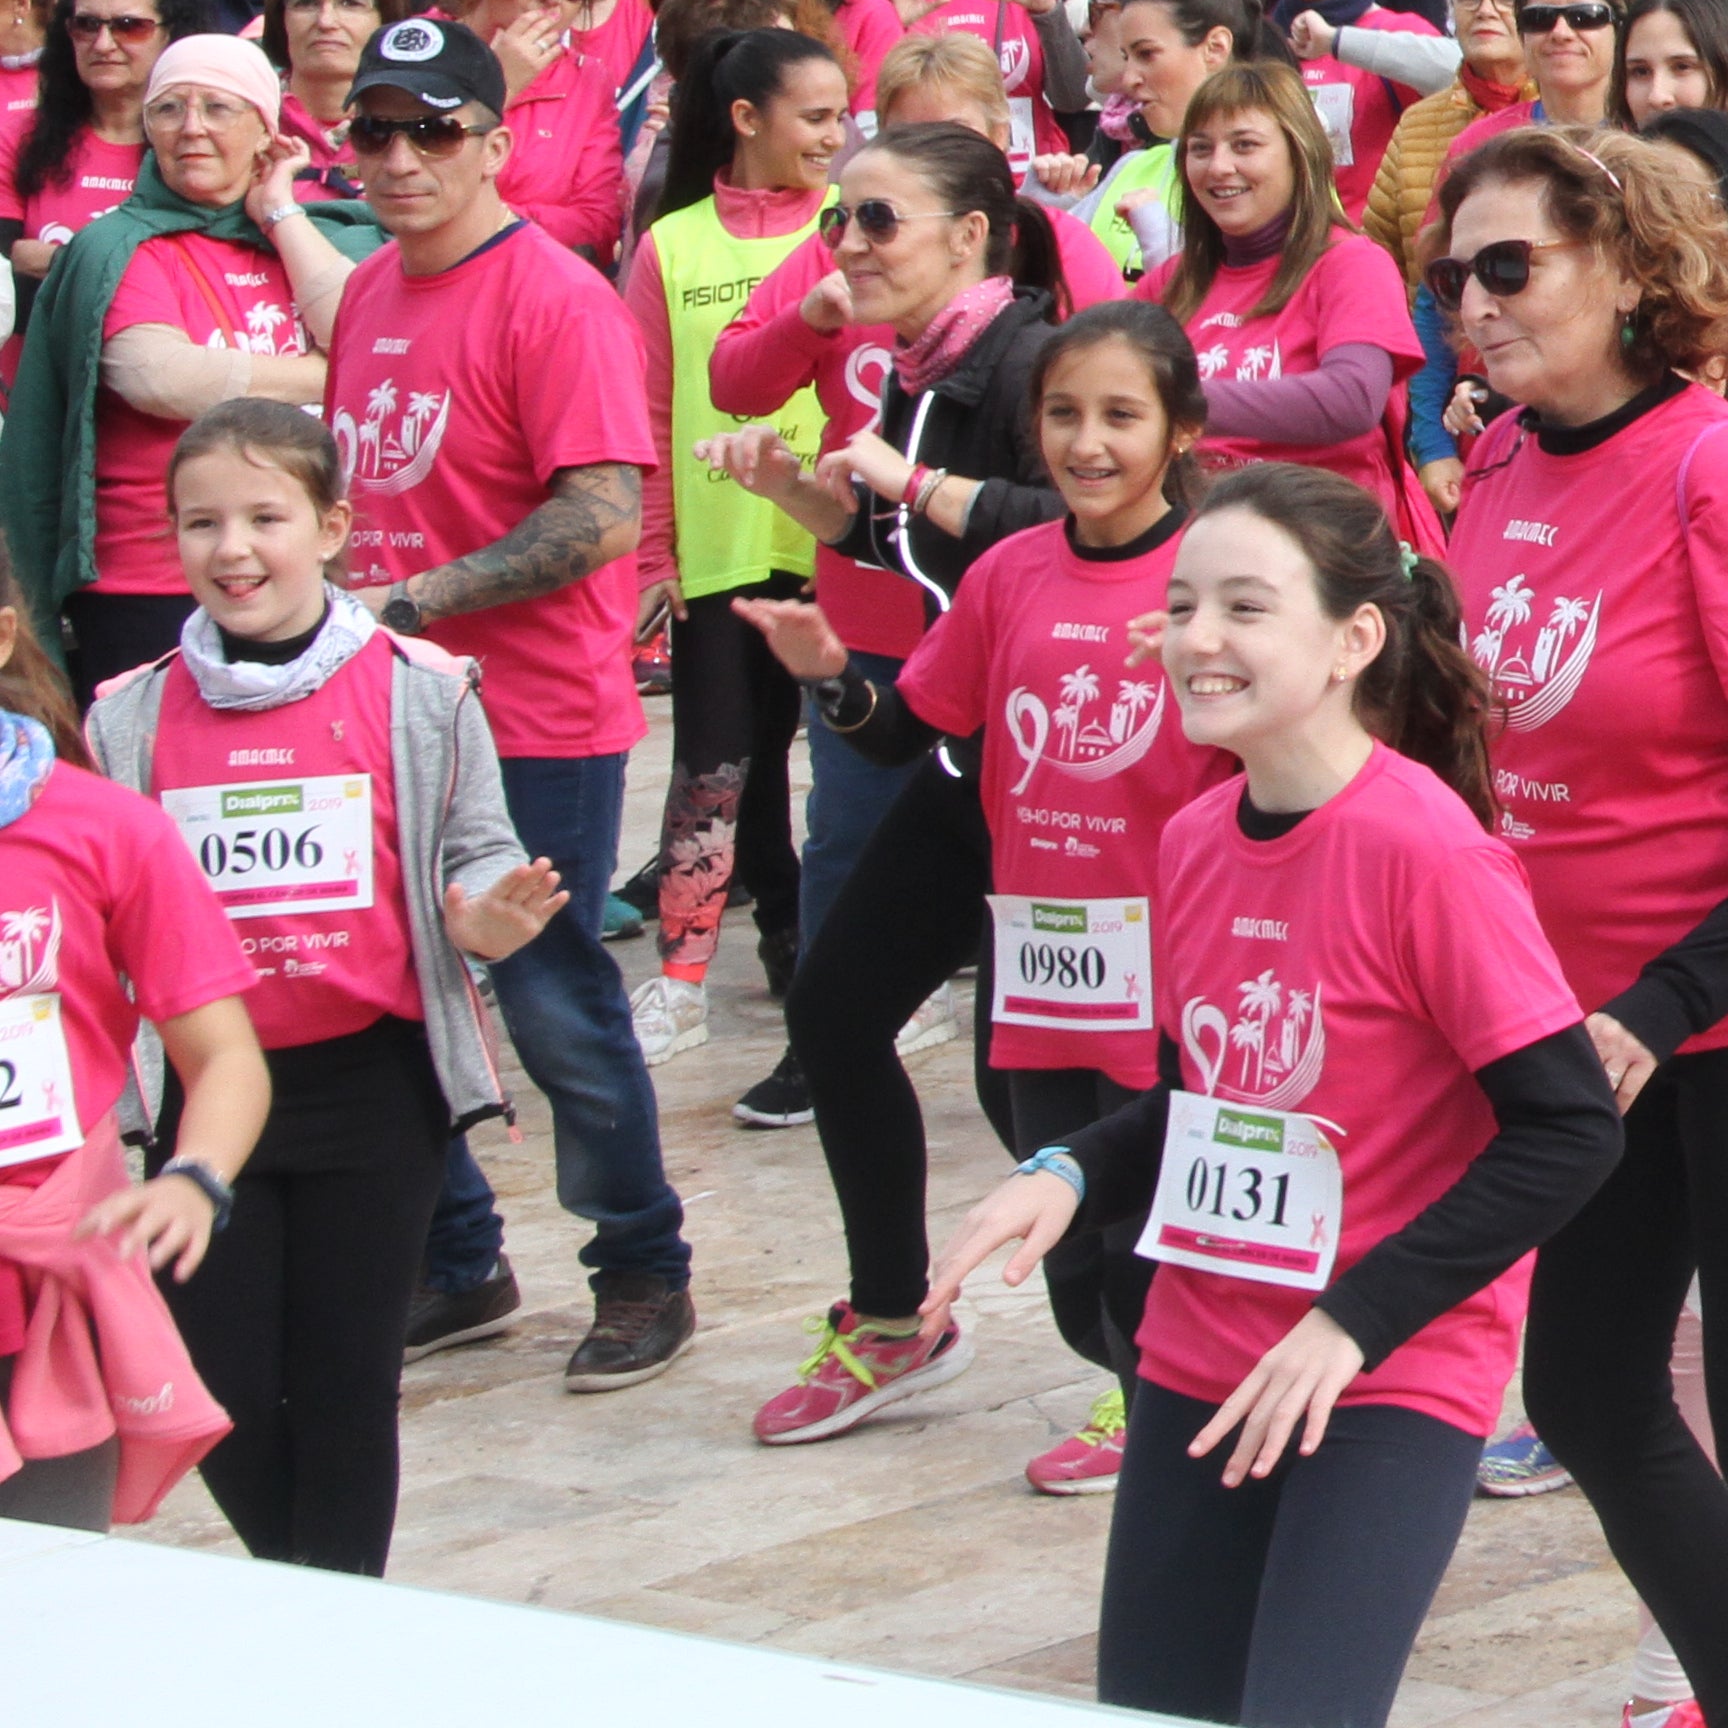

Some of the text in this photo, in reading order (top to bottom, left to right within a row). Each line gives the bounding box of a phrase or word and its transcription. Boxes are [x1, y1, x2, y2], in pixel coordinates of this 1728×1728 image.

[1502, 519, 1559, 548] AMACMEC
[1051, 622, 1111, 644] AMACMEC
[227, 748, 296, 766] AMACMEC
[1521, 776, 1572, 804] VIVIR
[307, 797, 343, 812] 2019
[1050, 810, 1081, 830] POR
[1085, 815, 1127, 834] VIVIR
[200, 823, 324, 878] 0506
[1090, 920, 1123, 934] 2019
[1231, 916, 1289, 942] AMACMEC
[259, 930, 350, 954] POR VIVIR
[1020, 941, 1106, 990] 0980
[1286, 1139, 1318, 1158] 2019
[1186, 1156, 1291, 1227] 0131
